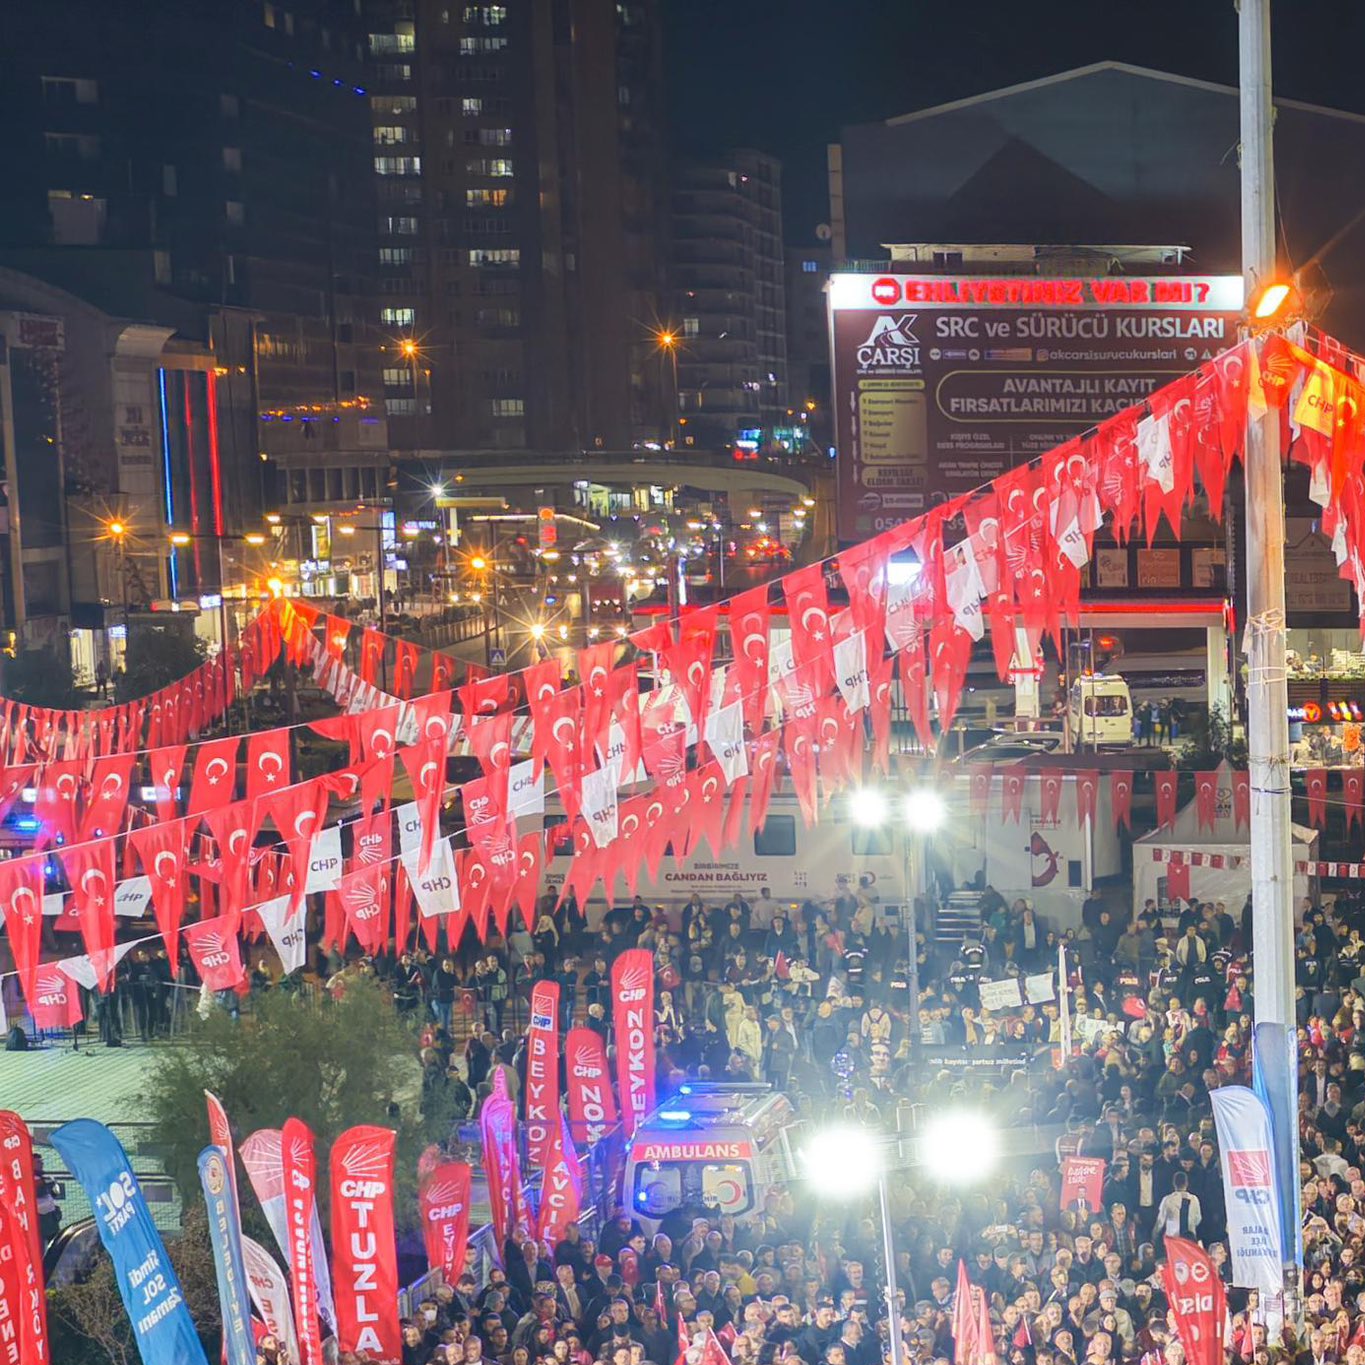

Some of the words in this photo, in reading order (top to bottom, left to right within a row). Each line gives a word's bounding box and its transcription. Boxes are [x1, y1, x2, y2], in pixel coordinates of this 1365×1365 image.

[1092, 280, 1149, 303] VAR
[936, 316, 978, 338] SRC
[985, 322, 1010, 338] ve
[1016, 312, 1108, 338] SÜRÜCÜ
[1117, 317, 1224, 339] KURSLARI
[857, 347, 919, 367] ÇARŞI
[1003, 378, 1100, 394] AVANTAJLI
[1104, 378, 1157, 394] KAYIT
[950, 397, 1087, 414] FIRSATLARIMIZI
[665, 872, 713, 883] CANDAN
[716, 870, 768, 883] BAĞLIYIZ
[529, 1038, 547, 1165] BEYKOZ
[644, 1143, 740, 1159] AMBULANS
[340, 1180, 386, 1198] CHP
[428, 1203, 463, 1220] CHP
[351, 1202, 384, 1353] TUZLA
